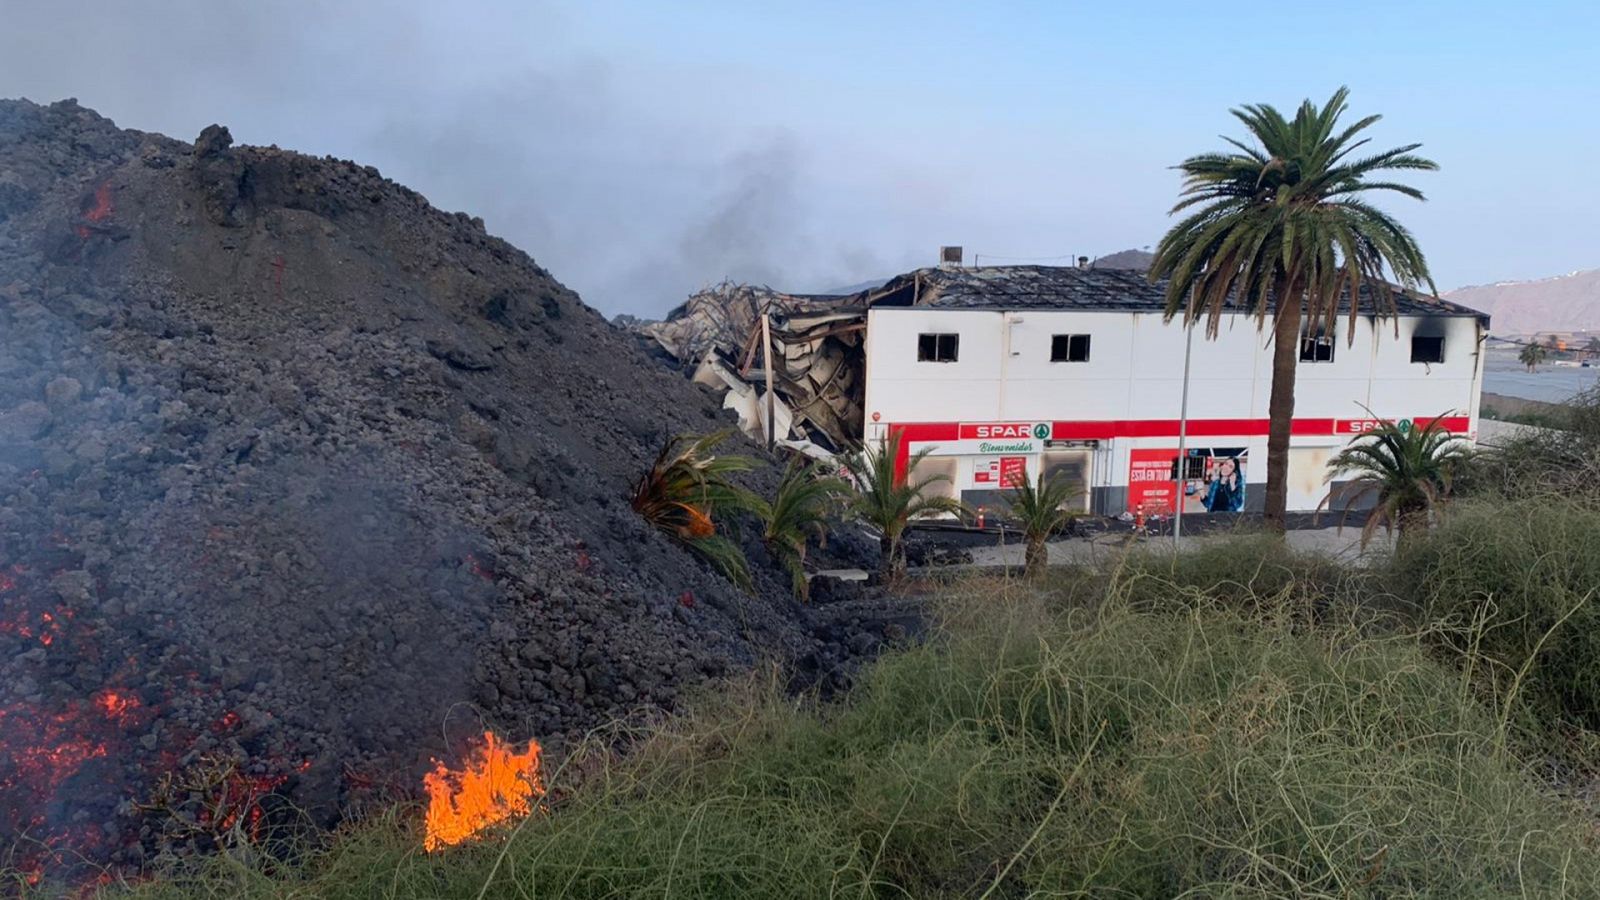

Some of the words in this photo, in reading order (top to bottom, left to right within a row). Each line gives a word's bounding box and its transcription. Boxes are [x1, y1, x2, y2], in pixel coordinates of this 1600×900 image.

[976, 426, 1031, 437] SPAR
[1350, 422, 1388, 432] SPA
[979, 442, 1033, 452] Bienvenidos
